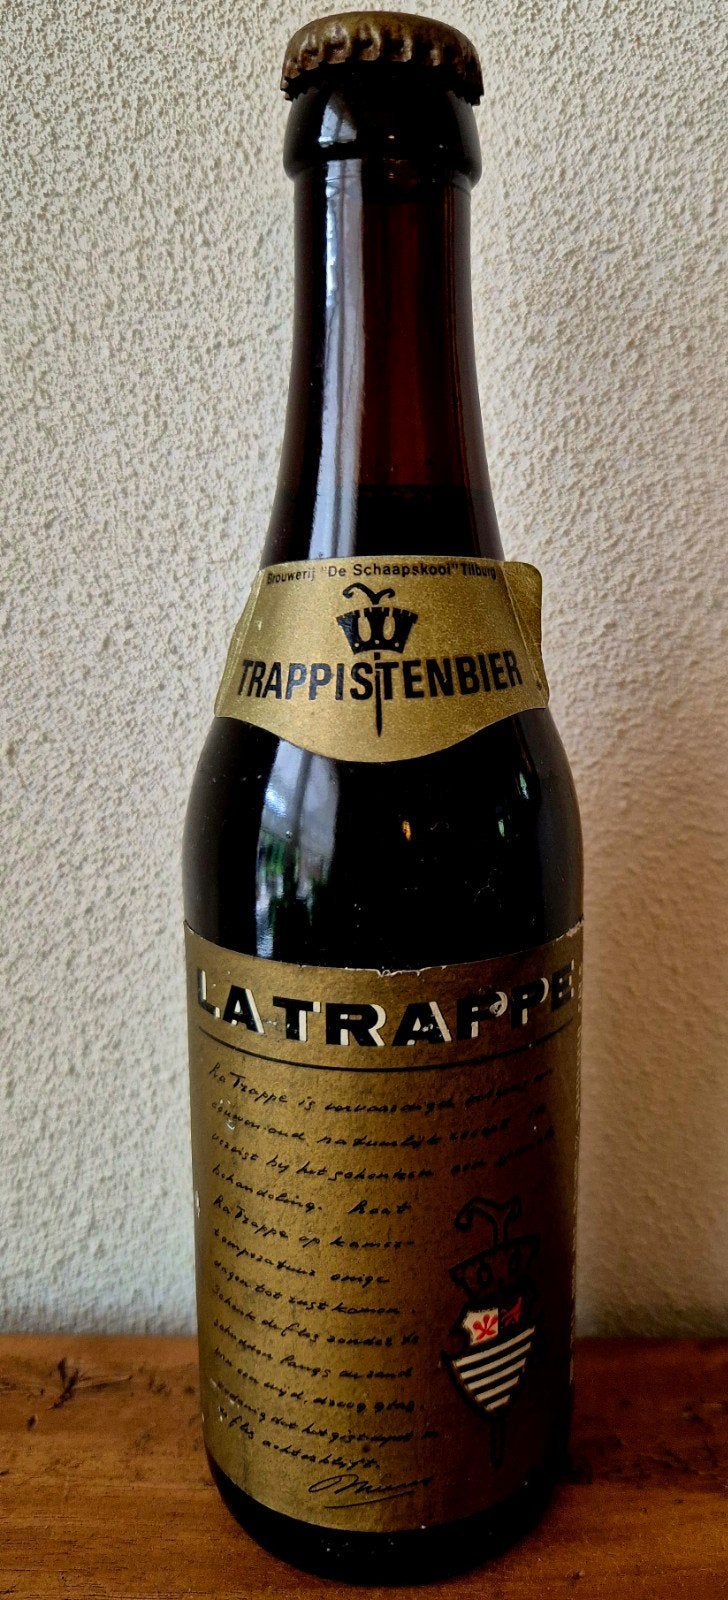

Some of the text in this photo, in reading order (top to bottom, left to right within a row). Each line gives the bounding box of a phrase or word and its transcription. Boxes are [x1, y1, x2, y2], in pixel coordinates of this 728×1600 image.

[461, 563, 497, 580] Tilburg
[238, 649, 523, 701] TRAPPISTENBIER
[272, 958, 575, 1047] TRAPPE
[229, 1071, 288, 1104] Trappe
[298, 1096, 316, 1112] is
[235, 1205, 289, 1239] Trappe
[299, 1235, 320, 1248] op
[214, 1228, 316, 1277] temperatuur
[254, 1284, 283, 1300] tot
[289, 1296, 329, 1311] rust
